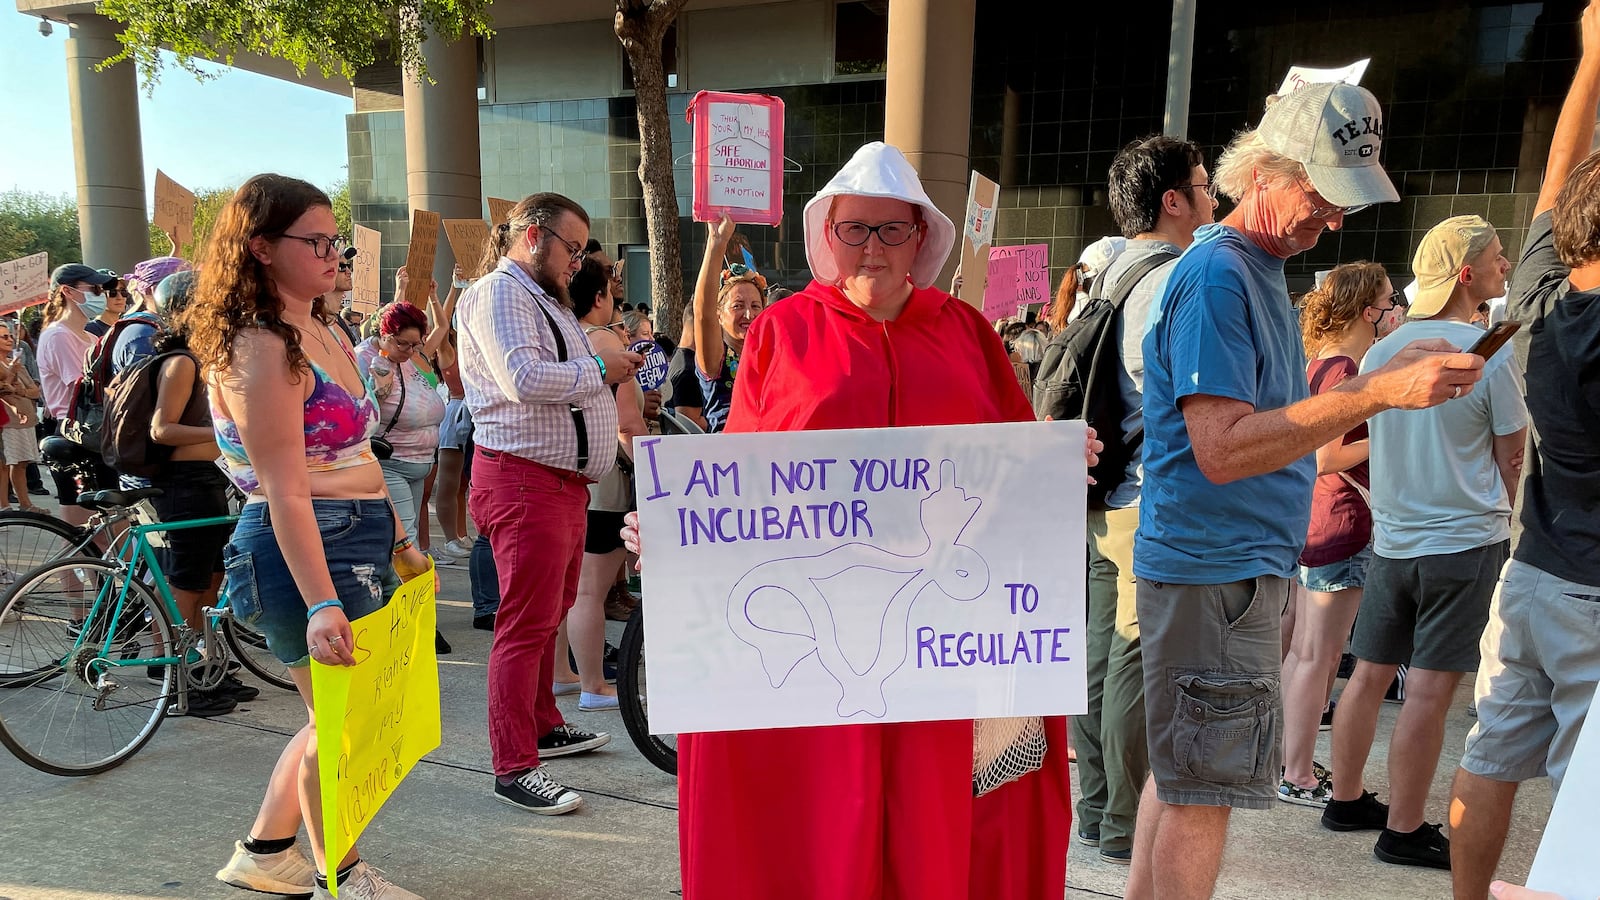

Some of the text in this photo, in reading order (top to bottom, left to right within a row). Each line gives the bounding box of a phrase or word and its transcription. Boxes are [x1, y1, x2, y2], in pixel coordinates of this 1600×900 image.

[1332, 116, 1382, 146] TEXA
[715, 145, 742, 158] SAFE
[1361, 147, 1372, 155] TX
[725, 157, 767, 169] ABORTION
[727, 175, 744, 183] NOT
[28, 253, 47, 269] GOP
[356, 247, 376, 268] BODY
[1025, 270, 1047, 282] NOT
[639, 367, 666, 387] EGAL
[640, 438, 670, 501] I
[684, 459, 740, 496] AM
[771, 458, 837, 496] NOT
[849, 458, 931, 493] YOUR
[677, 499, 873, 547] INCUBATOR
[1004, 583, 1039, 615] TO
[916, 626, 1070, 669] REGULATE
